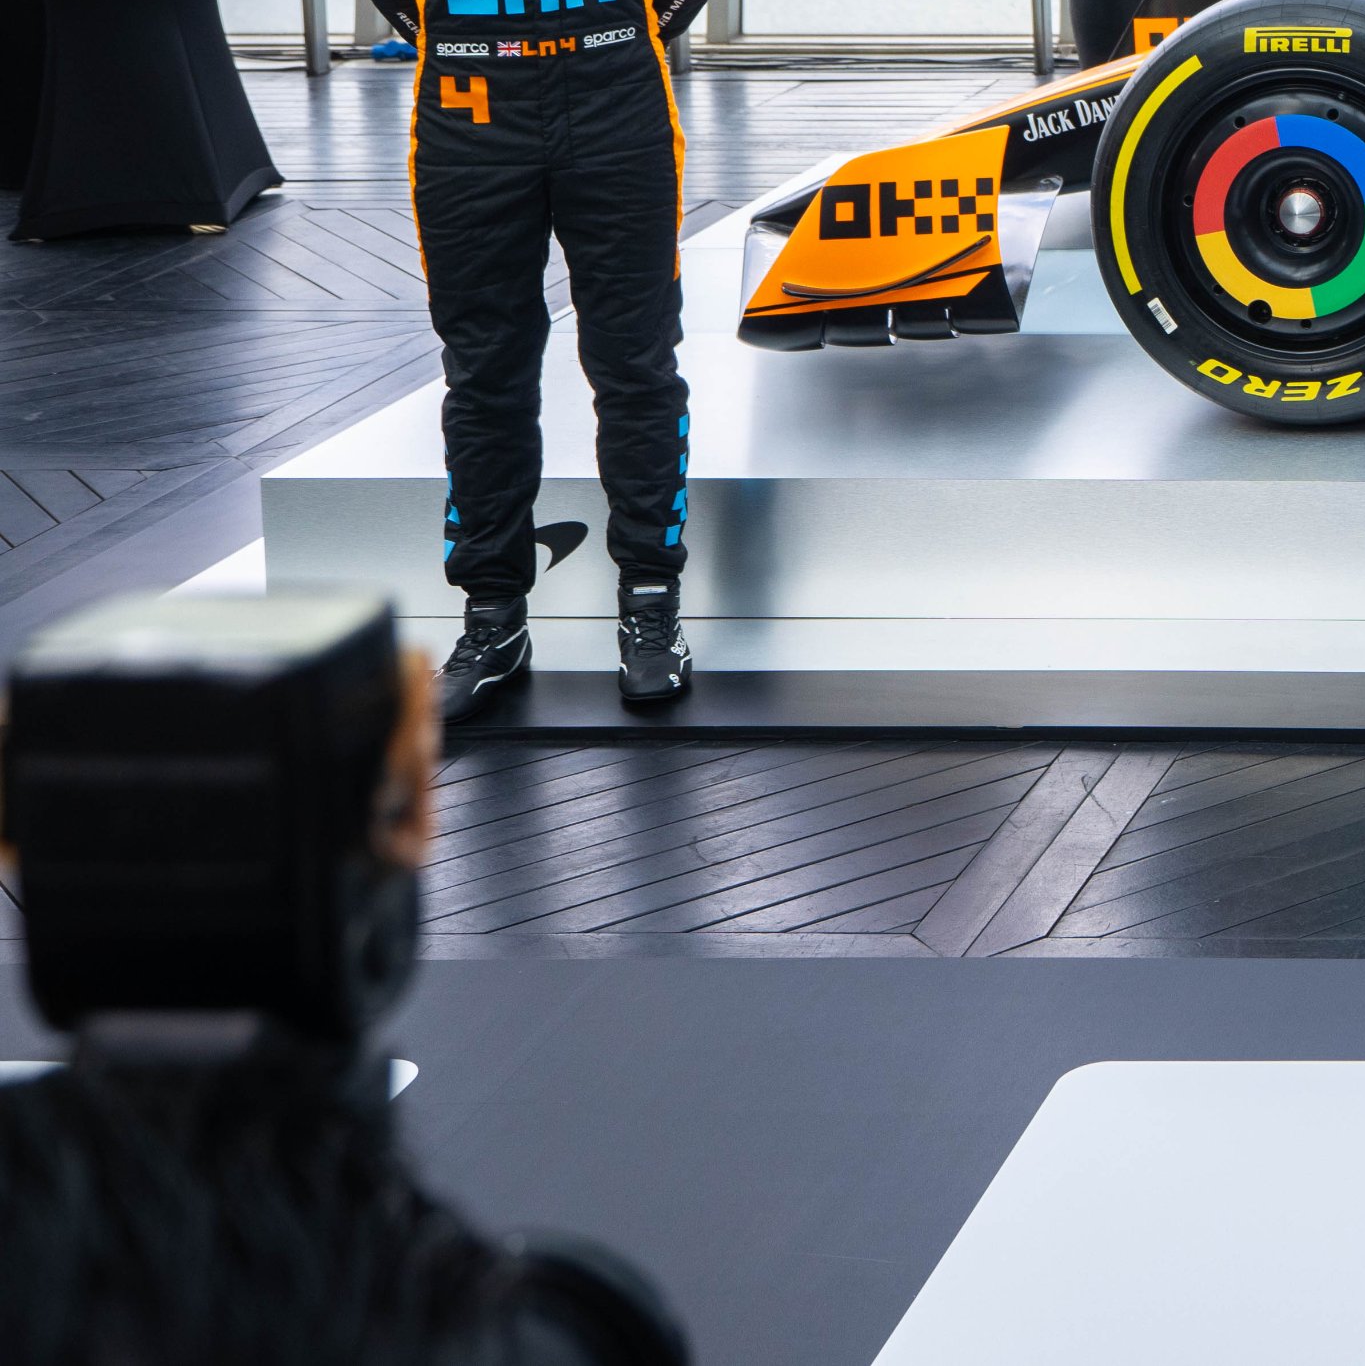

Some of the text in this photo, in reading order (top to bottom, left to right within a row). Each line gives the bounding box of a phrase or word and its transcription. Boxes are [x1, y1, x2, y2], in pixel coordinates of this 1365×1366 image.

[436, 42, 490, 57] sparco
[584, 27, 636, 49] sparco
[1244, 26, 1354, 53] PIRELLI
[440, 76, 491, 124] 4
[1023, 113, 1076, 142] JACK
[819, 177, 994, 241] OKX
[1196, 358, 1363, 402] ZERO
